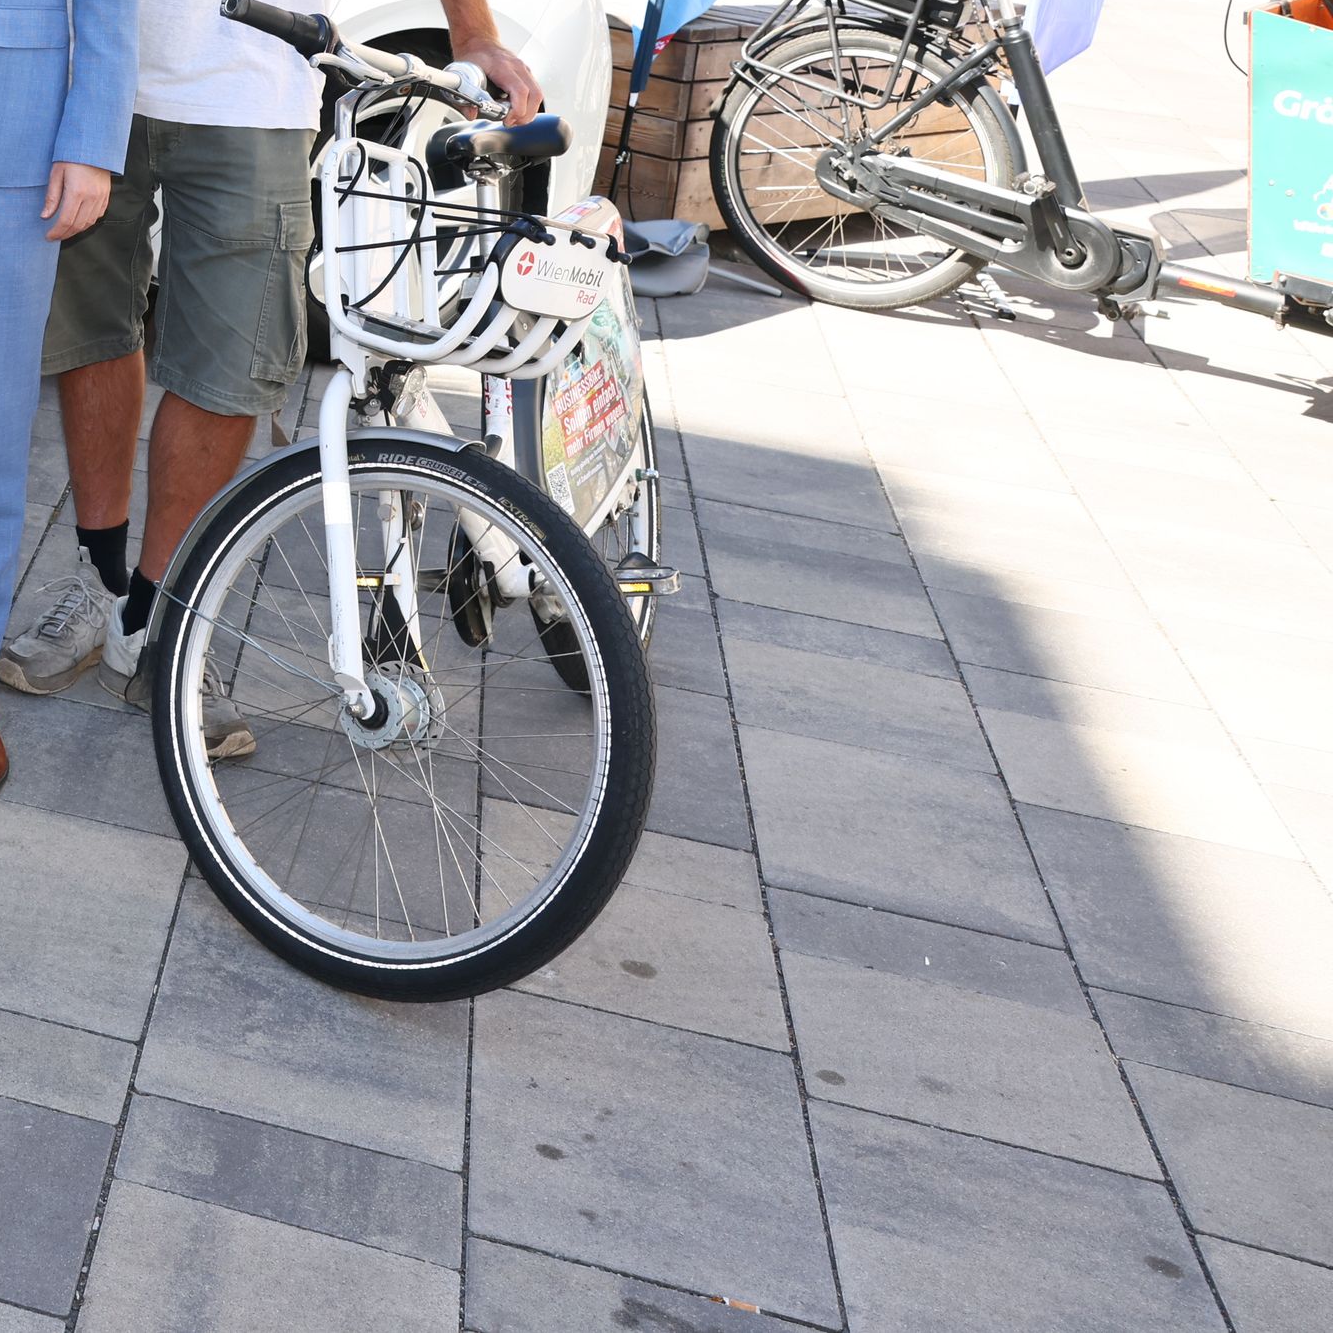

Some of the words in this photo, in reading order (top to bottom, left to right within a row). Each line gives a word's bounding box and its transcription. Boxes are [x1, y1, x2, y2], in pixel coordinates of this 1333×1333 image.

[537, 259, 604, 288] WienMobil
[576, 290, 597, 305] Rad
[567, 439, 584, 458] mehr
[377, 453, 416, 465] RIDE
[417, 457, 467, 479] CRUISER
